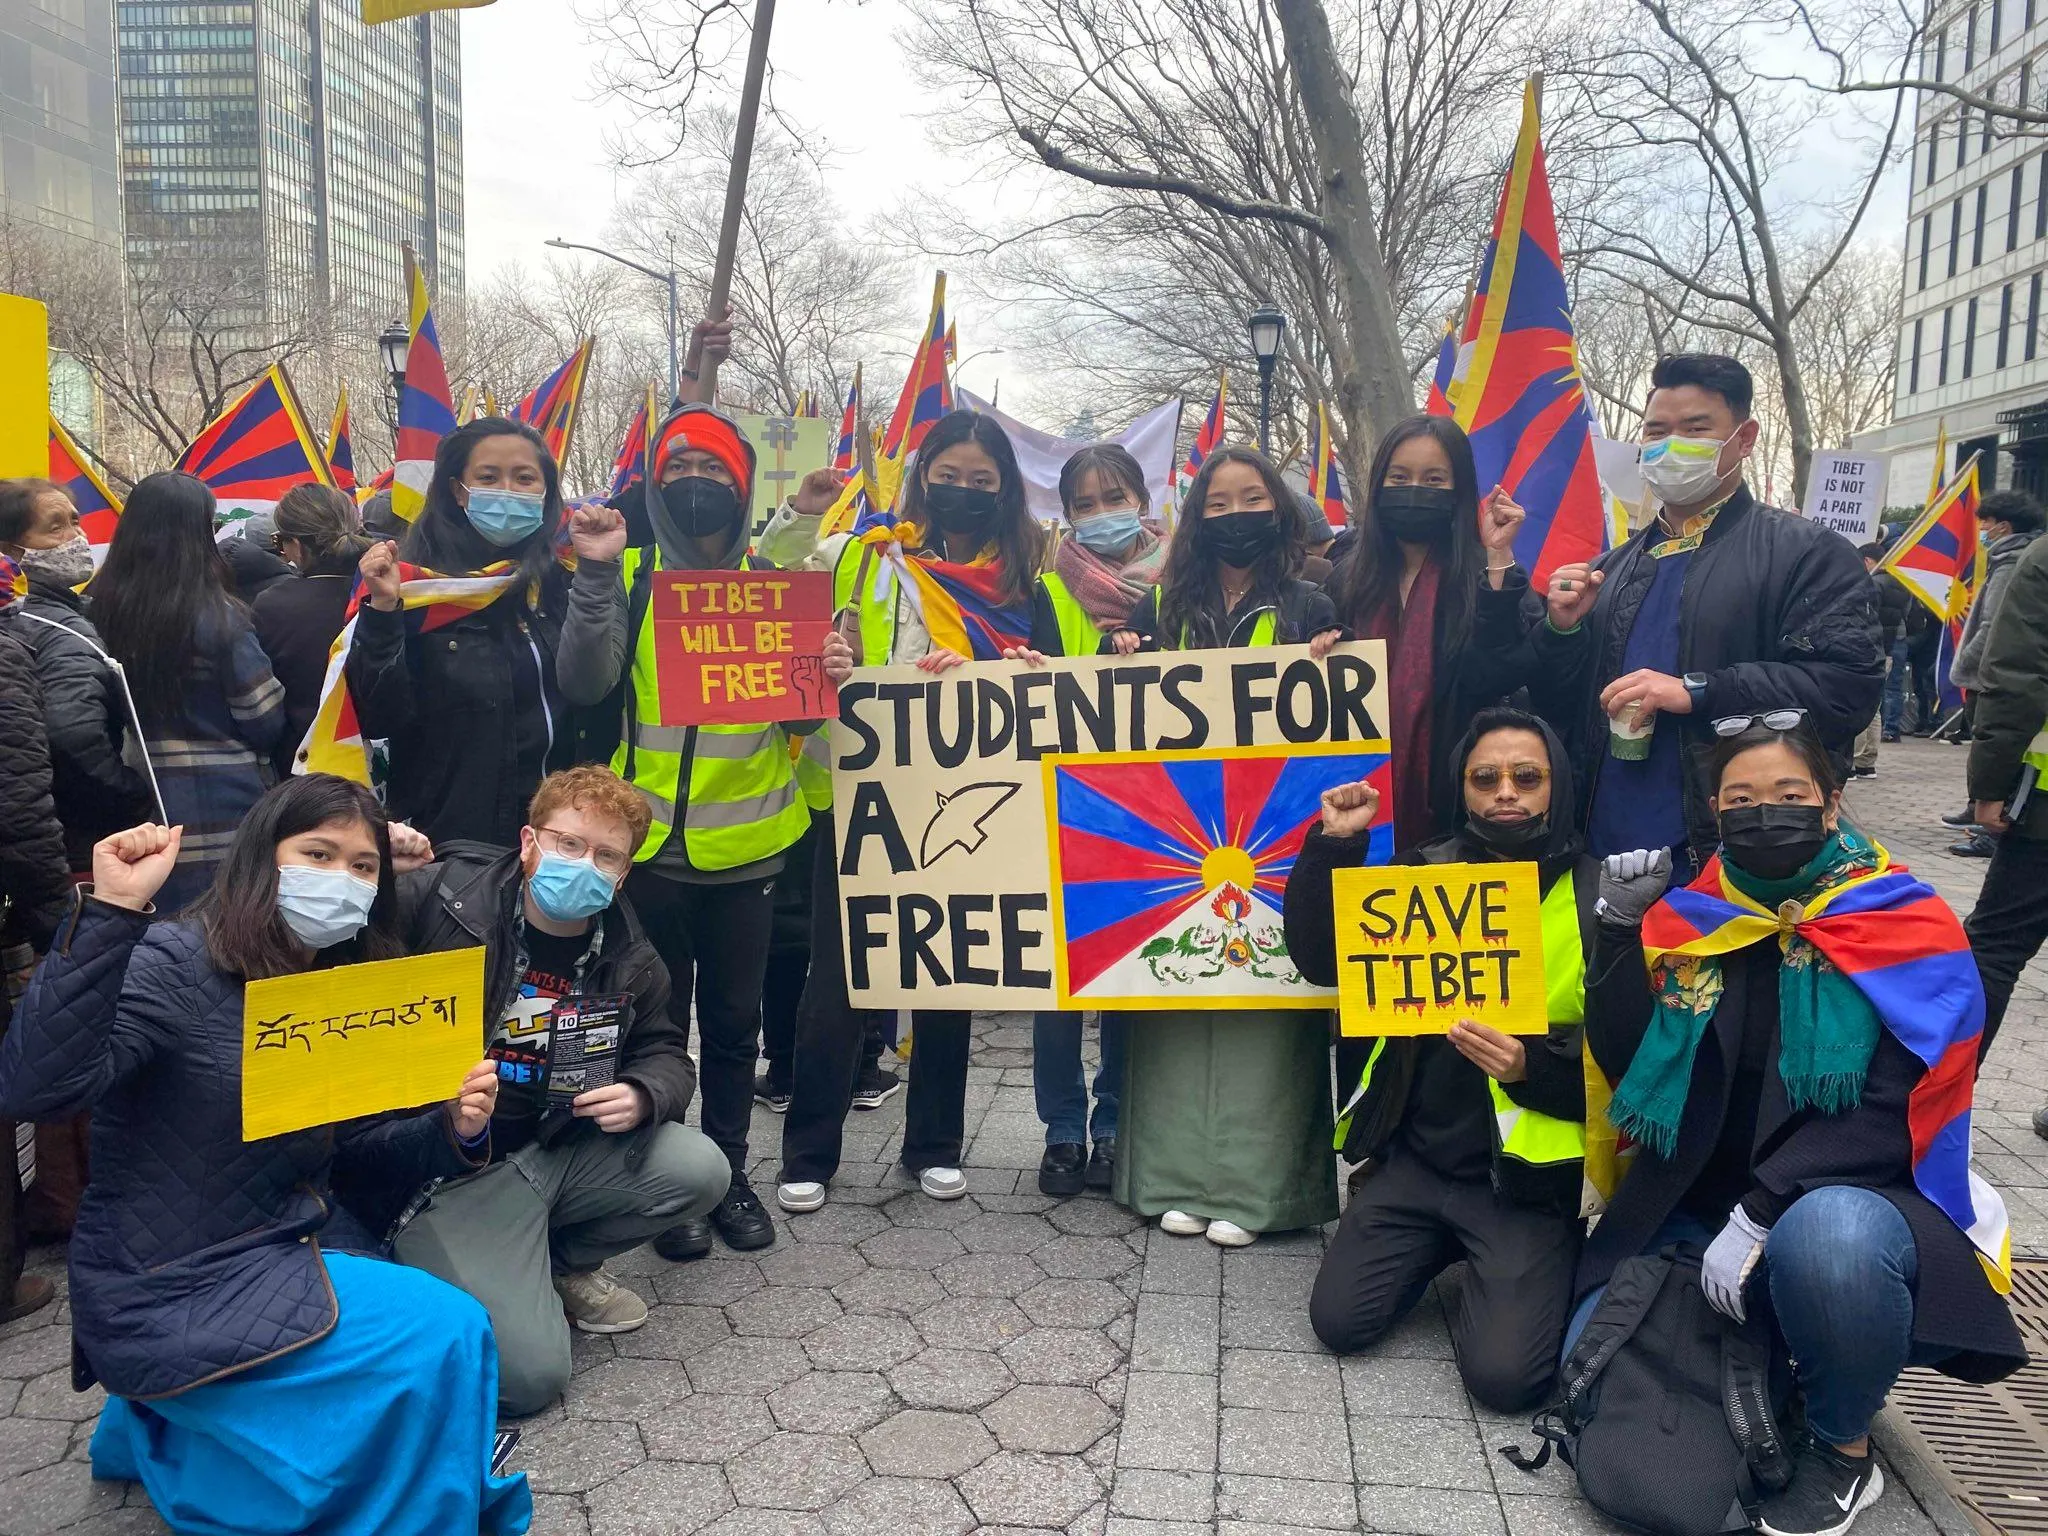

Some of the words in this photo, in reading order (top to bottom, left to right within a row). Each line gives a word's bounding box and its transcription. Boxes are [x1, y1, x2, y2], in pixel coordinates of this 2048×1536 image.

[1832, 461, 1866, 475] TIBET
[1824, 478, 1837, 491] IS
[1840, 480, 1866, 494] NOT
[1819, 499, 1828, 512] A
[1831, 500, 1863, 515] PART
[1812, 516, 1827, 526] OF
[1829, 518, 1866, 534] CHINA
[670, 581, 791, 614] TIBET
[680, 623, 748, 654] WILL
[754, 621, 794, 654] BE
[700, 661, 787, 704] FREE
[838, 664, 1209, 771] STUDENTS
[1231, 655, 1383, 748] FOR
[840, 781, 917, 876] A
[1359, 881, 1508, 943] SAVE
[846, 893, 1053, 991] FREE
[1347, 950, 1521, 1010] TIBET
[560, 1017, 575, 1028] 10
